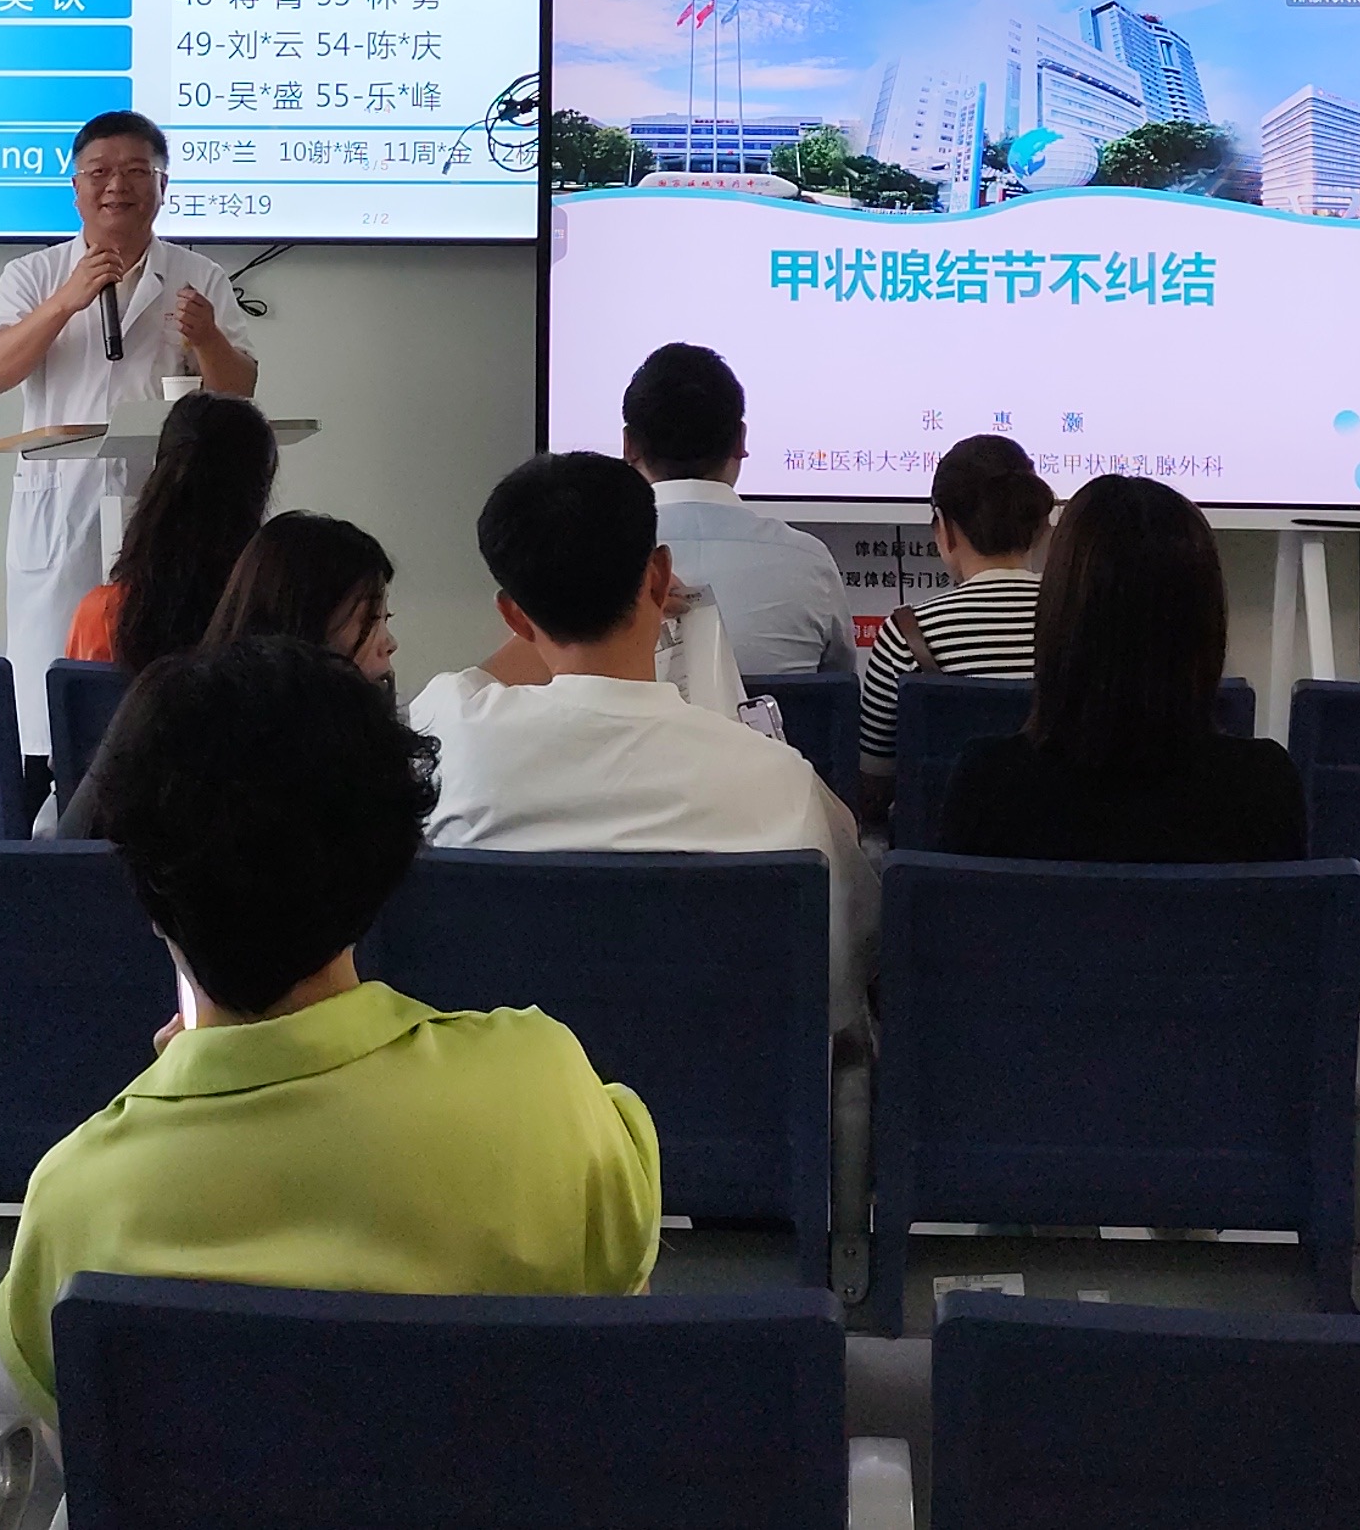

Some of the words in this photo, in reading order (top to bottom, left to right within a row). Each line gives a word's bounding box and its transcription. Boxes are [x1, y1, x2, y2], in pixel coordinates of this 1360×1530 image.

[770, 247, 1218, 307] 甲状腺结节不纠结
[839, 571, 959, 589] 现体检与门诊
